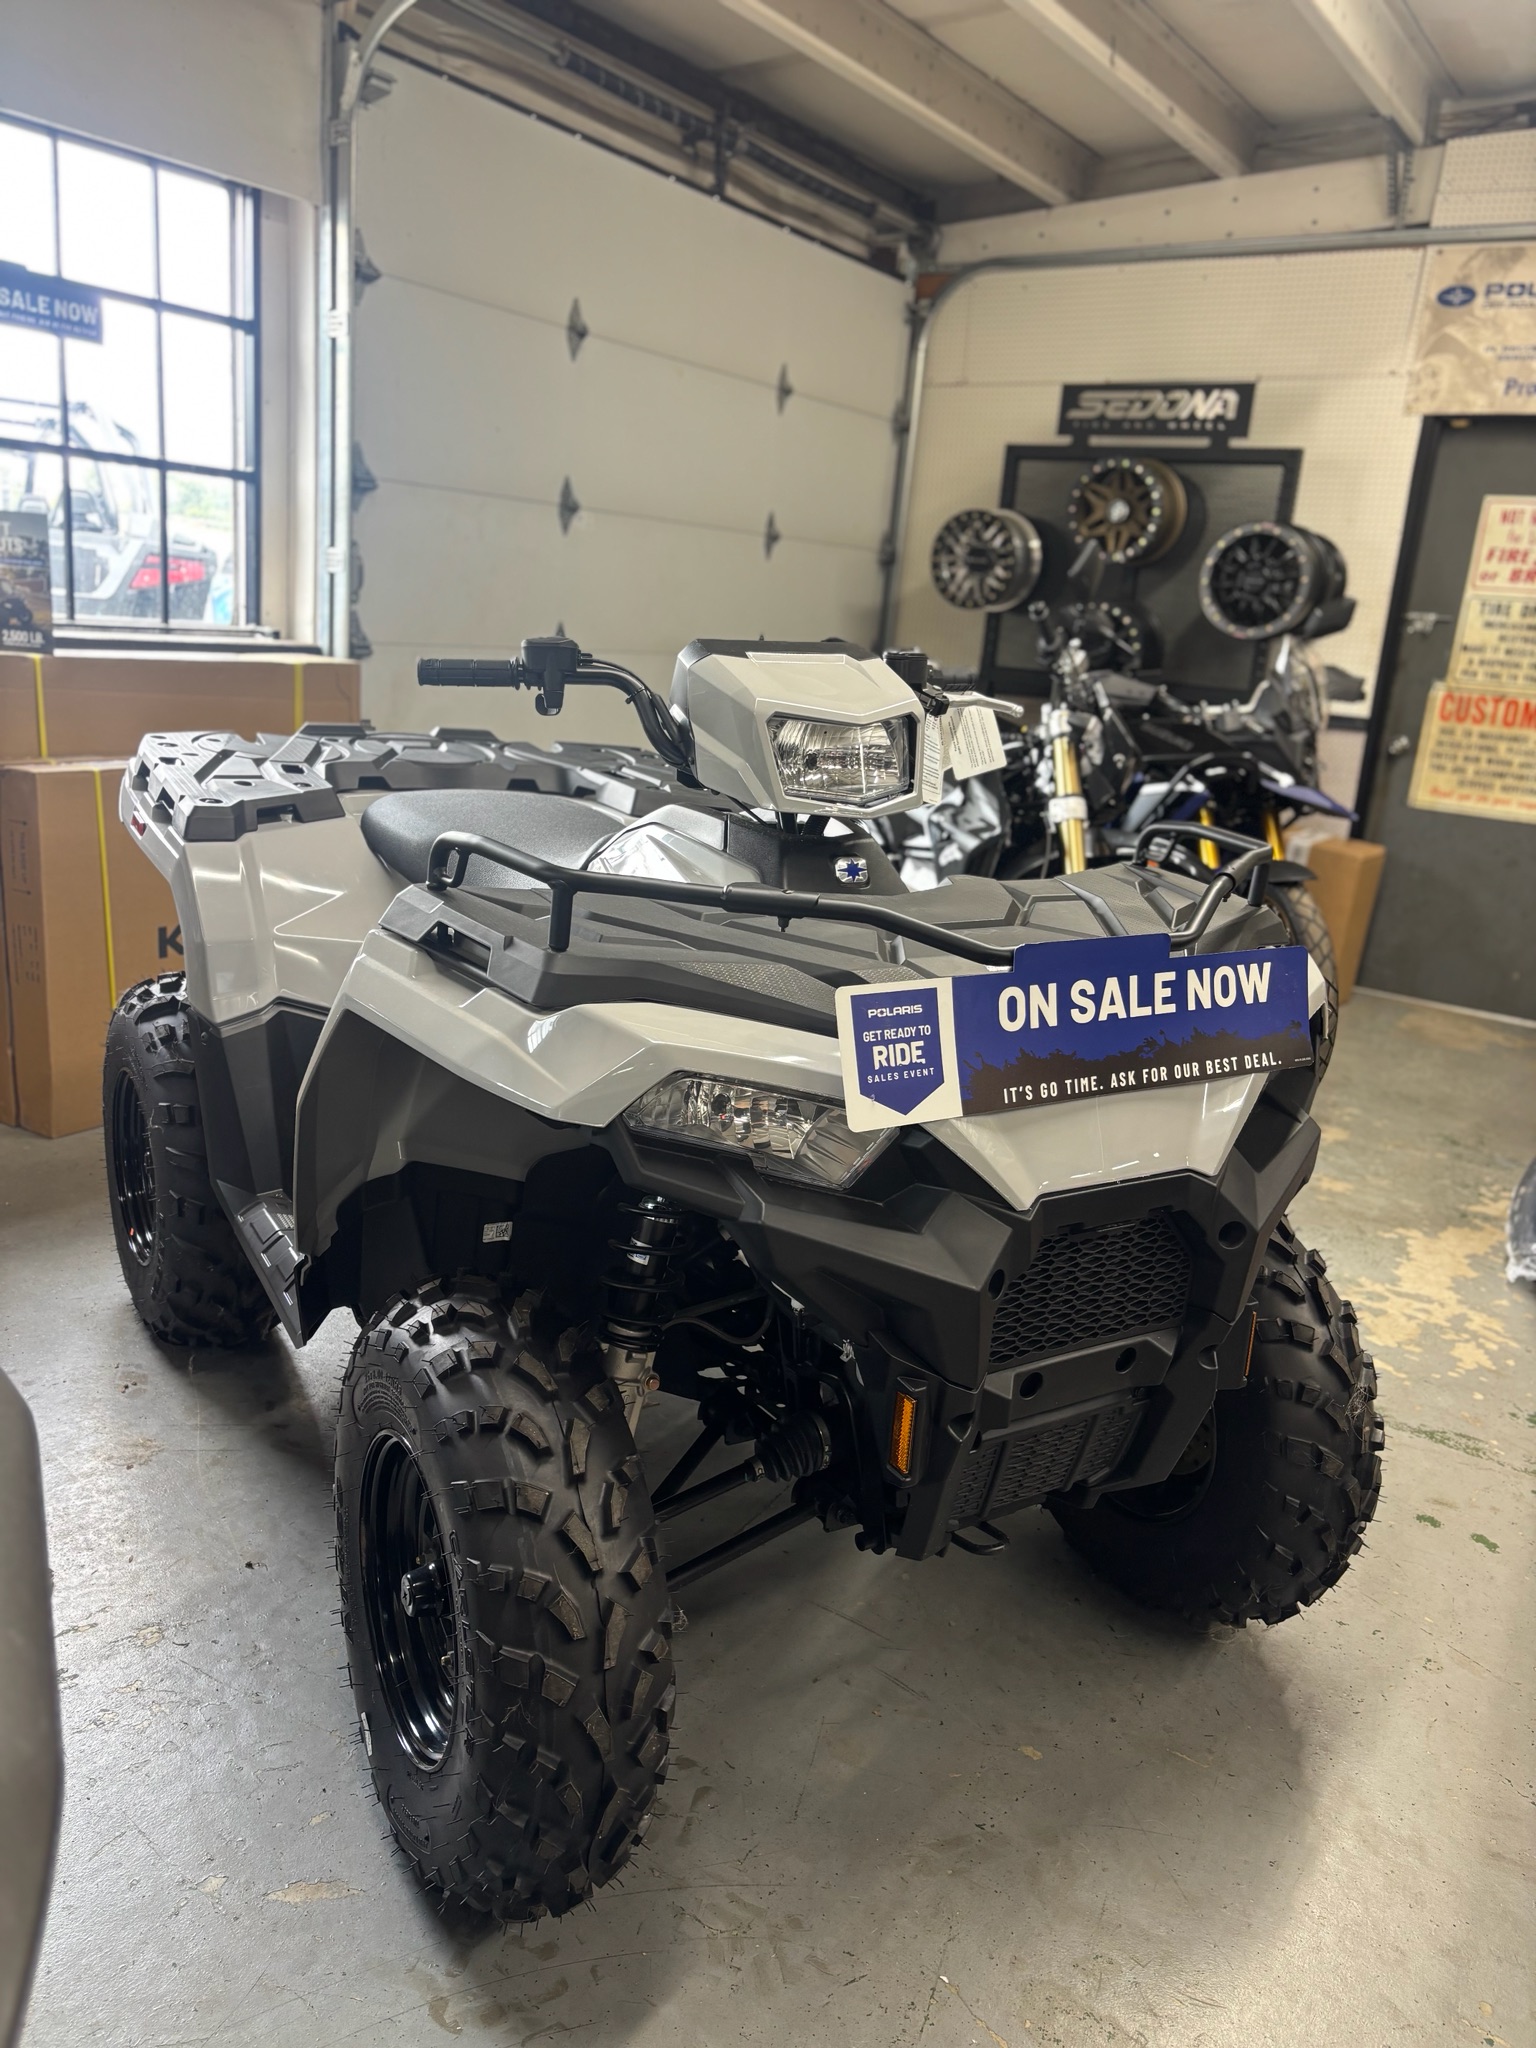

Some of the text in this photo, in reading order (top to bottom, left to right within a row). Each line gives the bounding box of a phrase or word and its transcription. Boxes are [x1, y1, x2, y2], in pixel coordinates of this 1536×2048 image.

[0, 287, 50, 316] SALE
[54, 299, 97, 325] NOW
[1065, 388, 1240, 420] SEDONA
[867, 1004, 923, 1018] POLARIS
[998, 961, 1272, 1032] ON SALE NOW
[863, 1024, 931, 1042] GET READY TO
[872, 1040, 926, 1070] RIDE
[867, 1067, 935, 1084] SALES EVENT
[1003, 1051, 1282, 1104] IT'S GO TIME. ASK FOR OUR BEST DEAL.
